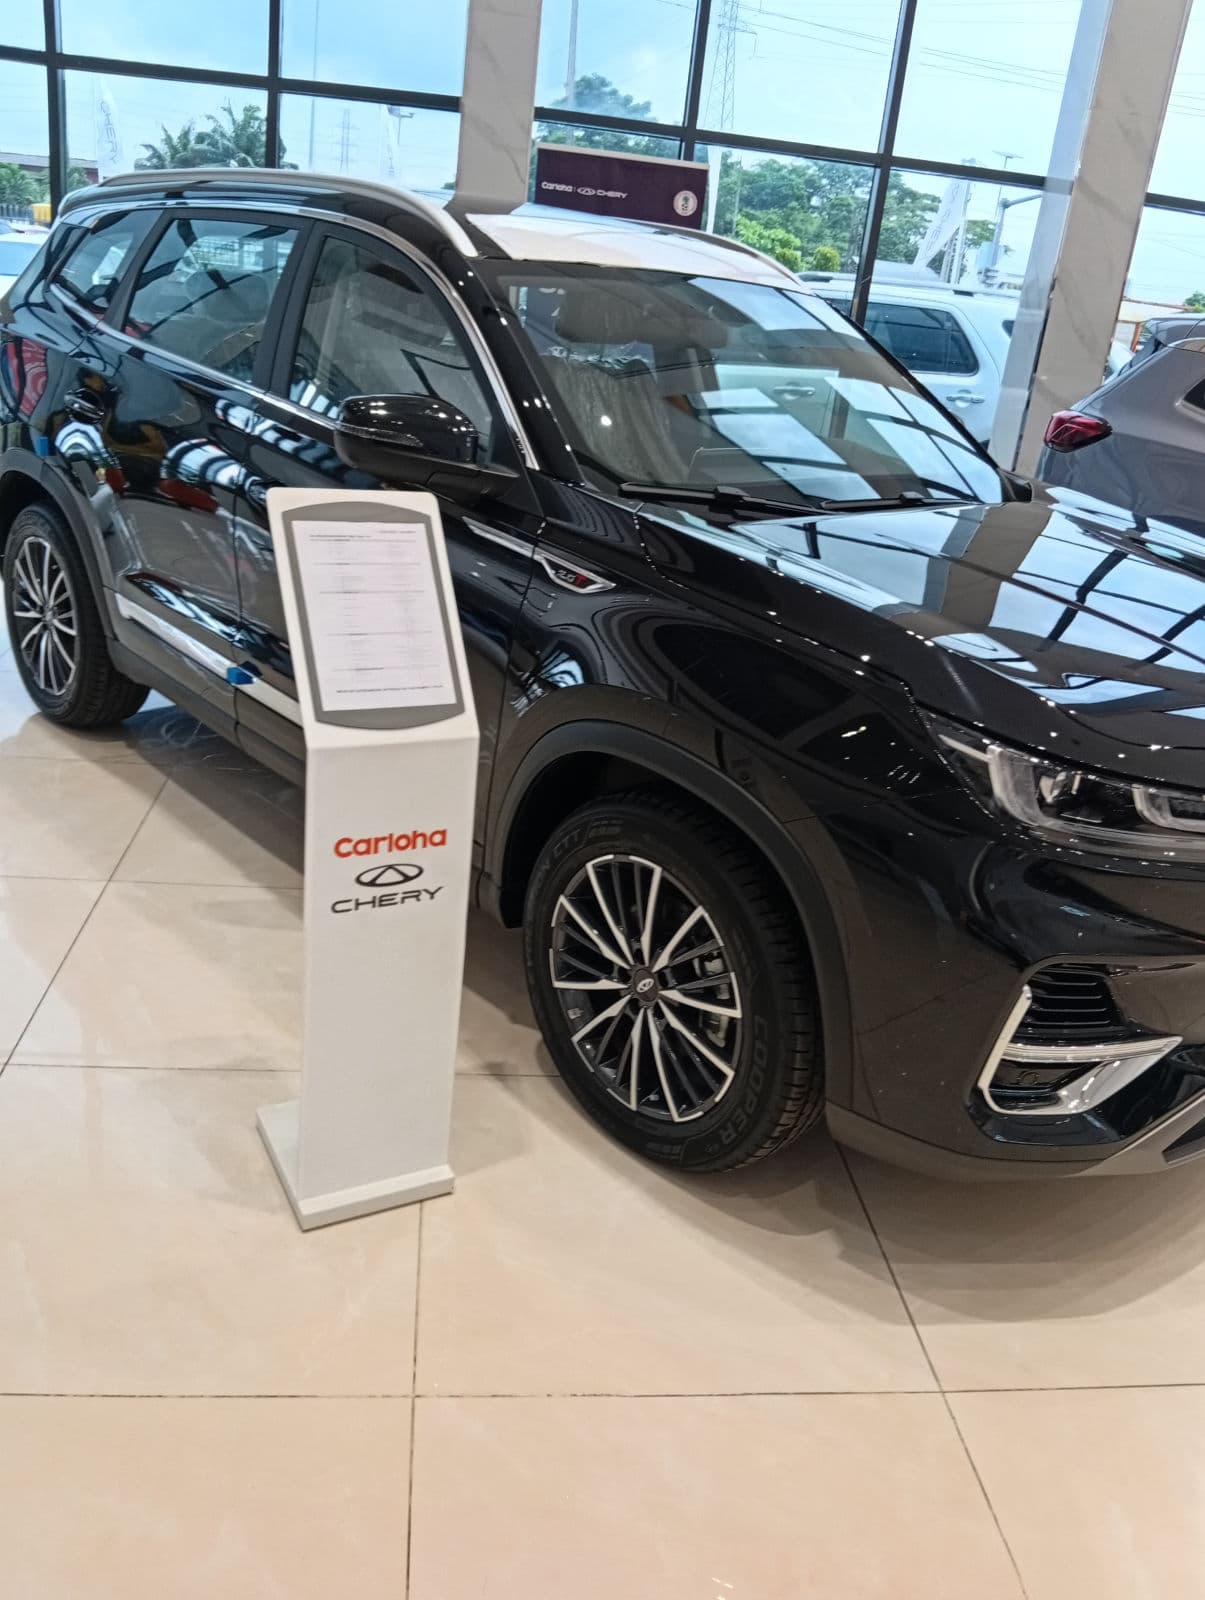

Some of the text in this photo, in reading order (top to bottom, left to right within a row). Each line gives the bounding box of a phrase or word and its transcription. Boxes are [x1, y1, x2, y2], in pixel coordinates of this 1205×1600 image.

[596, 189, 629, 199] CHERY
[334, 828, 448, 858] Carloha
[331, 886, 444, 914] CHERY
[719, 1014, 768, 1145] COOPER
